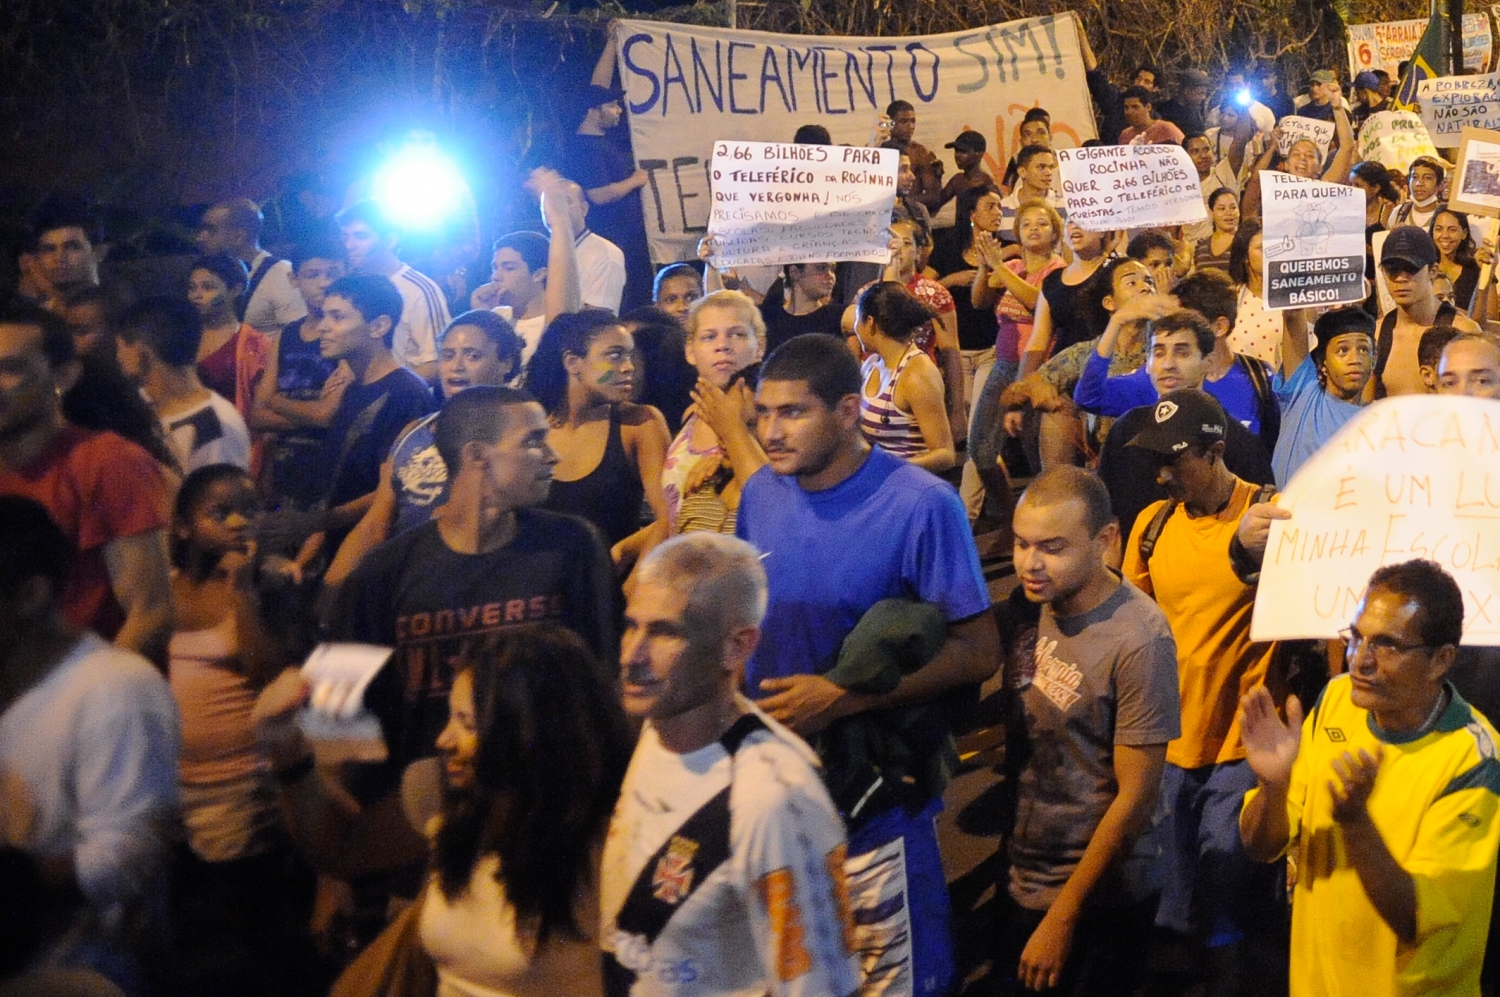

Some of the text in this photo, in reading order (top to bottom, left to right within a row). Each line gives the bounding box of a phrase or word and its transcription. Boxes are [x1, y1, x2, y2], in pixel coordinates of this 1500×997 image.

[1358, 43, 1372, 65] 6
[622, 14, 1066, 116] SANEAMENTO SIM!
[1434, 105, 1488, 120] NÃO SÃO
[716, 144, 752, 161] 2,66
[843, 148, 881, 164] PARA
[1059, 150, 1070, 161] A
[1075, 146, 1127, 161] GIGANTE
[1089, 156, 1179, 175] ROCINHA NÃO
[713, 170, 721, 180] O
[729, 166, 814, 184] TELEFÉRICO
[842, 170, 893, 187] ROCINHA
[1062, 180, 1100, 193] QUER
[1112, 178, 1138, 191] 2,66
[1273, 186, 1354, 201] PARA QUEM?
[715, 191, 740, 202] QUE
[1067, 197, 1098, 209] PARA
[1104, 196, 1113, 204] O
[1117, 184, 1182, 203] TELEFÉRICO
[713, 207, 799, 221] PRECISAMOS
[1279, 258, 1350, 274] QUEREMOS
[1270, 272, 1357, 290] SANEAMENTO
[1289, 288, 1340, 304] BÁSICO!
[1171, 441, 1189, 452] FILA
[1385, 474, 1432, 507] UM
[1275, 529, 1370, 565] MINHA
